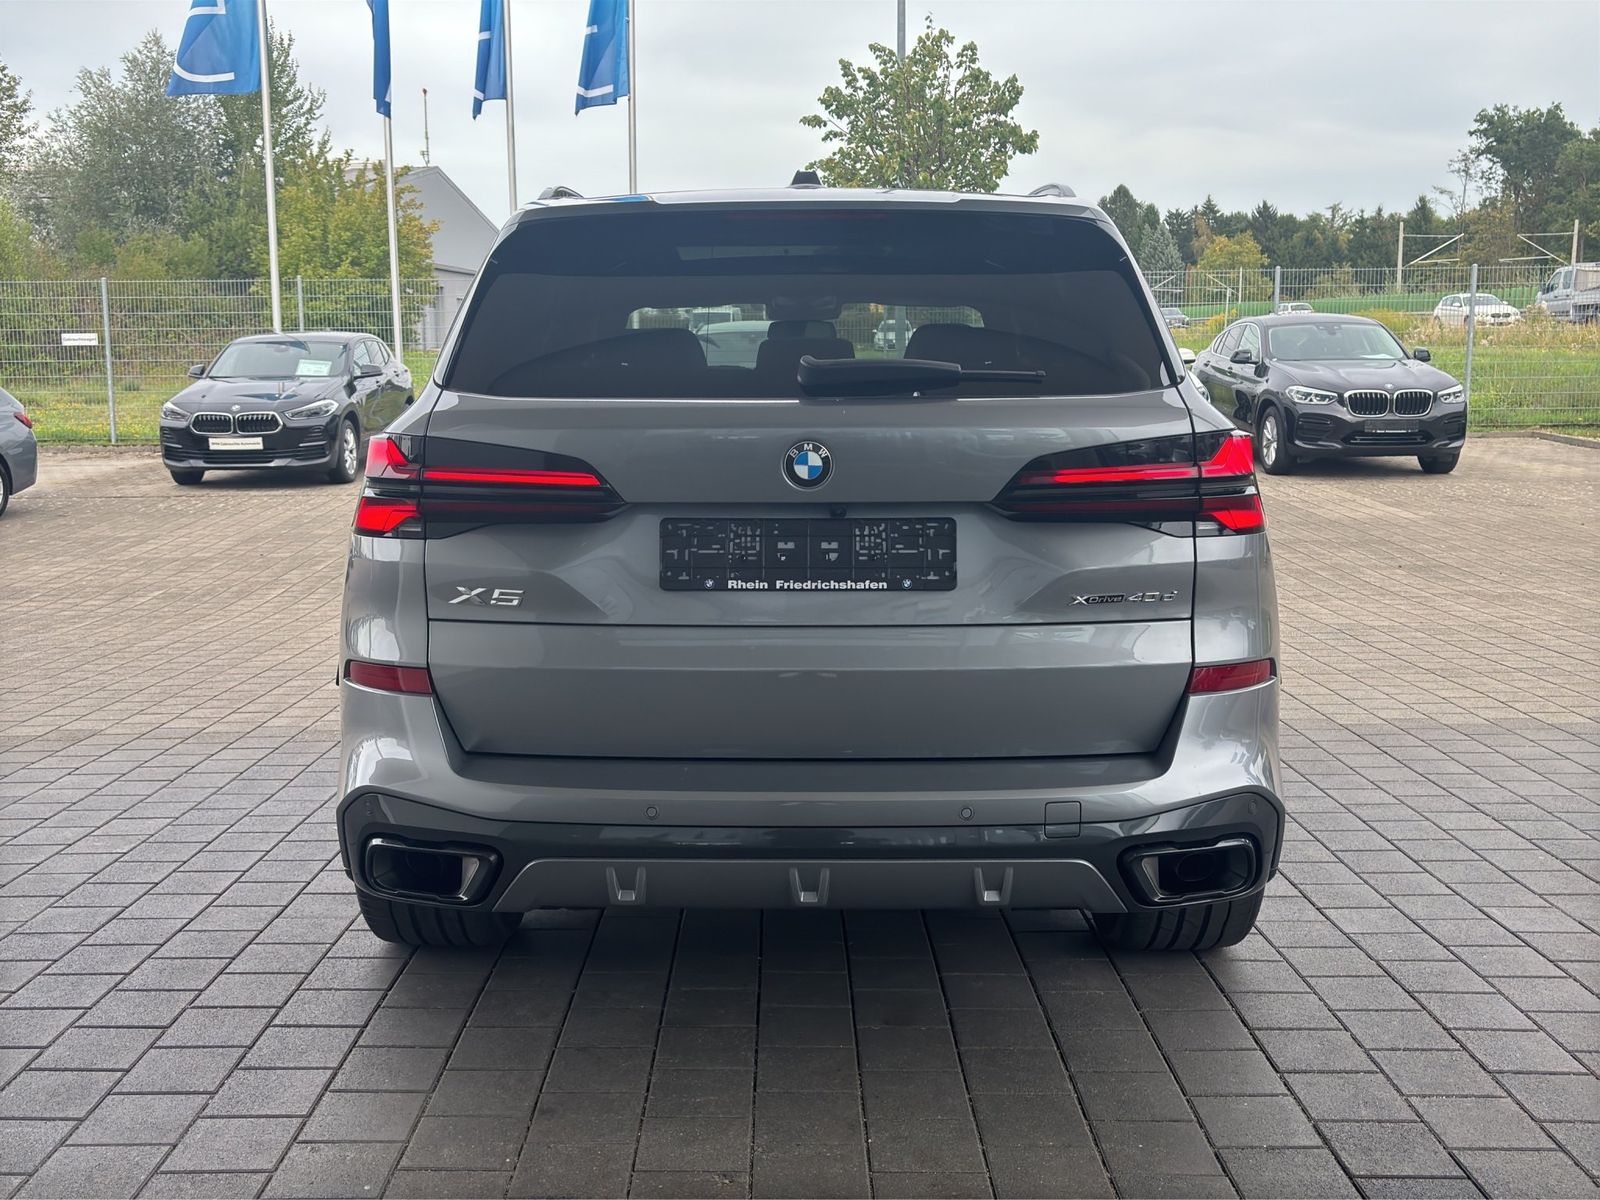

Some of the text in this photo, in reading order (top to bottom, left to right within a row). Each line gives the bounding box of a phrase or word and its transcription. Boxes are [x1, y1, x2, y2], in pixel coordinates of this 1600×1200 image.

[789, 443, 828, 458] BMW
[727, 580, 888, 589] Rhein Friedrichshafen
[448, 586, 524, 606] X5
